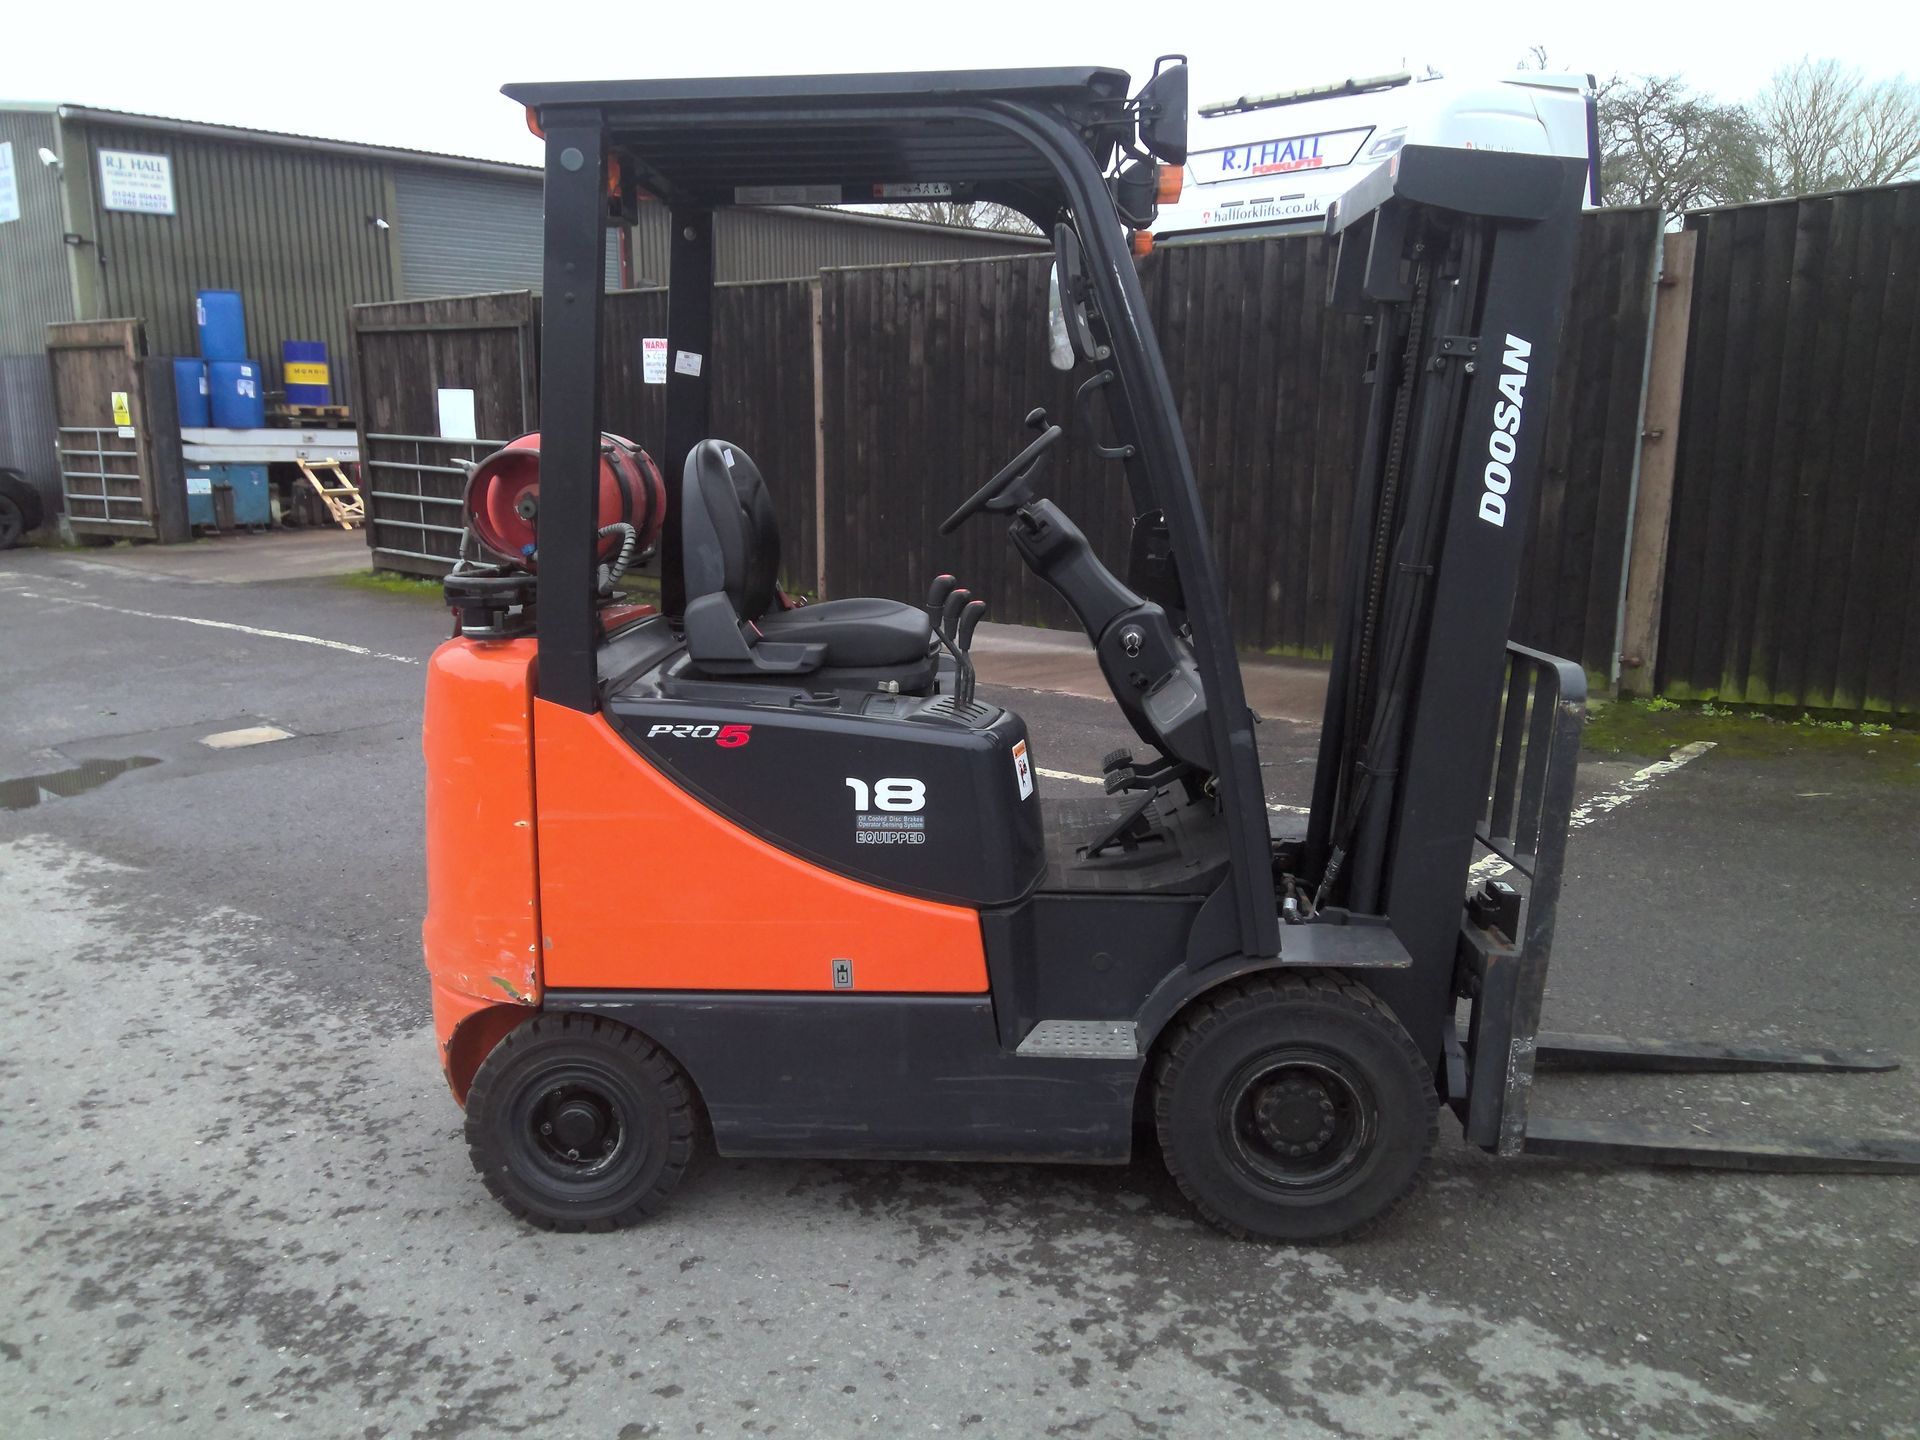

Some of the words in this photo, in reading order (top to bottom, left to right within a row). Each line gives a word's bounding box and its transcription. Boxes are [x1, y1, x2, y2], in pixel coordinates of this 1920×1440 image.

[130, 158, 163, 173] HALL
[1213, 199, 1321, 222] hallforklifts.co.uk
[1478, 333, 1532, 528] DOOSAN
[845, 777, 927, 812] 18
[858, 821, 881, 829] Operator
[882, 821, 903, 829] Sensing
[903, 821, 924, 829] System
[903, 815, 924, 823] Brakes
[855, 831, 926, 844] EQUIPPED
